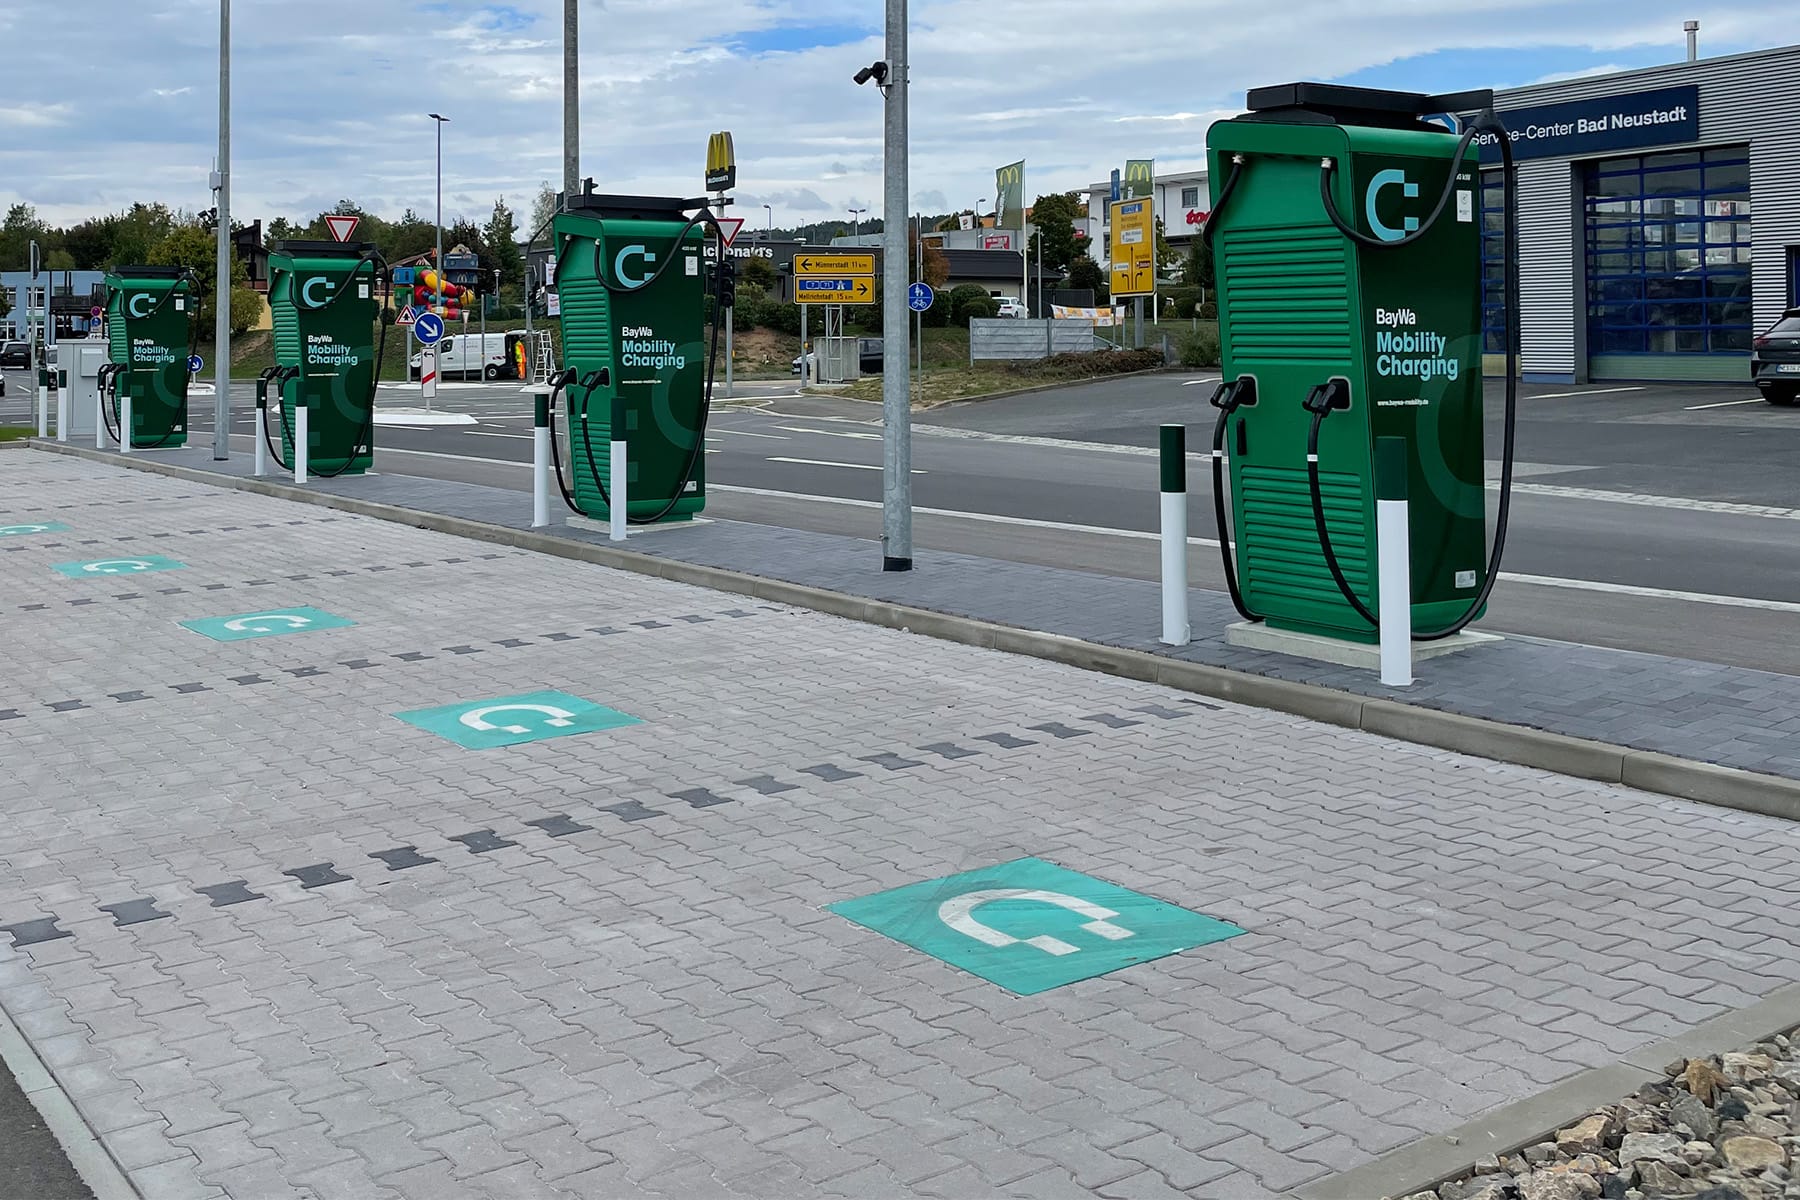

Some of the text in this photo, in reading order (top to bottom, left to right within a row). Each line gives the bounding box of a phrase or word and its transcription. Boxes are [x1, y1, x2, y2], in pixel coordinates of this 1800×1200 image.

[1469, 106, 1687, 146] Serve-Center Bad Neustadt
[1376, 308, 1416, 328] BayWa
[307, 335, 333, 344] BayWa
[622, 326, 653, 339] BayWa
[133, 346, 169, 355] Mobility
[307, 344, 351, 355] Mobility
[622, 340, 676, 355] Mobility
[1376, 331, 1447, 356] Mobility
[133, 354, 176, 363] Charging
[307, 354, 359, 366] Charging
[622, 353, 685, 369] Charging
[1376, 354, 1459, 381] Charging
